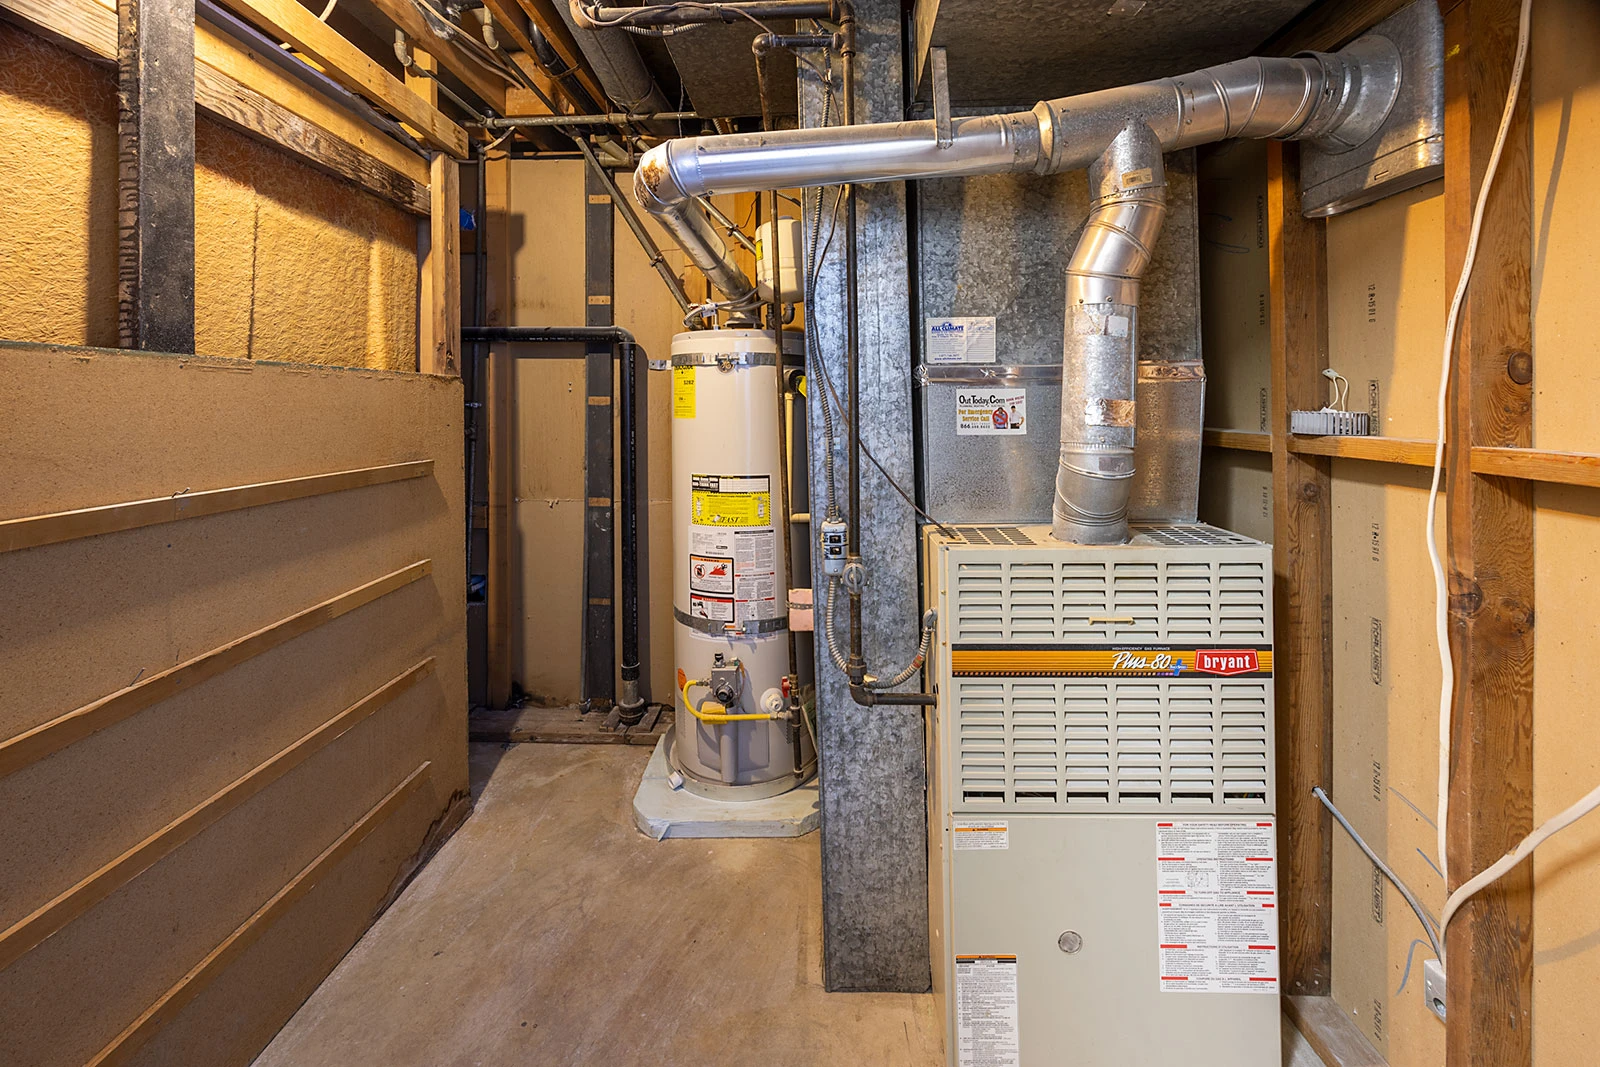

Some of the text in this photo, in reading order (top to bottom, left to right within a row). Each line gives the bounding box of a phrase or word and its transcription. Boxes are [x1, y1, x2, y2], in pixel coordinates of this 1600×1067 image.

[1112, 651, 1172, 670] Plus 80
[1204, 655, 1250, 670] bryant
